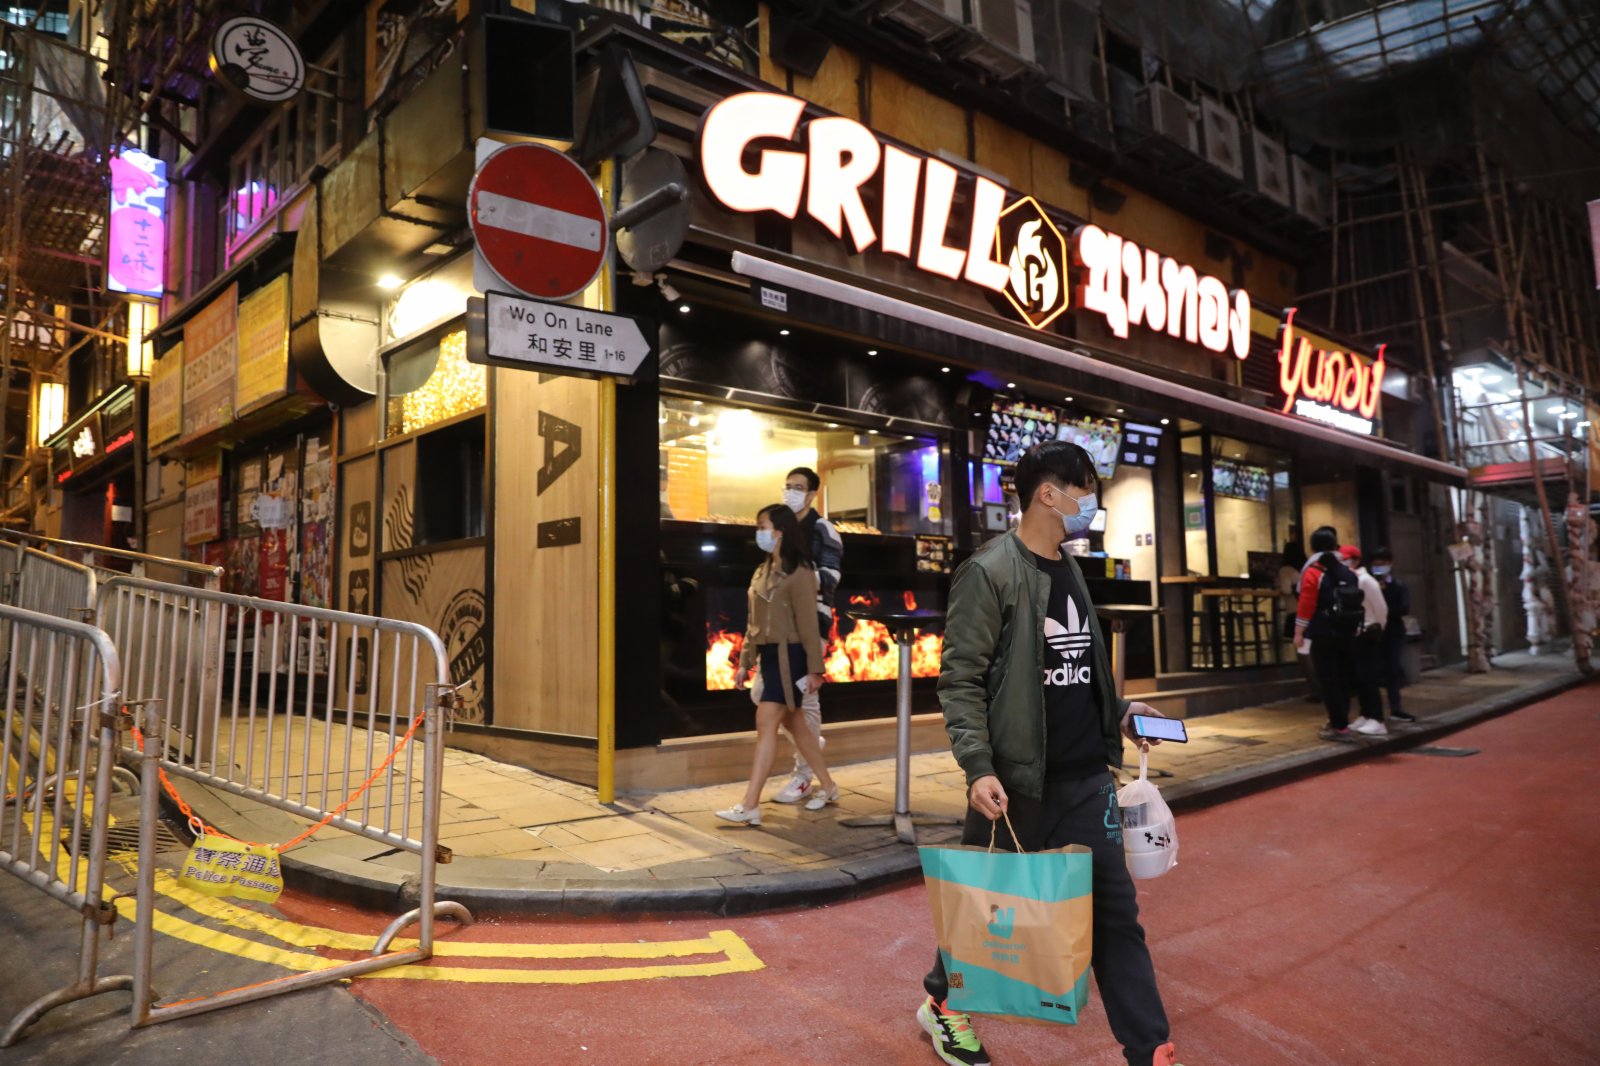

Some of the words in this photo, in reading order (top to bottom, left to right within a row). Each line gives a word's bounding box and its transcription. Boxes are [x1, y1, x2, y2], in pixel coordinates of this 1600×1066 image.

[701, 91, 1012, 293] GRILL
[509, 305, 536, 325] Wo
[544, 311, 567, 330] On
[576, 317, 613, 337] Lane
[527, 333, 597, 362] 和安里
[604, 348, 626, 362] 1-16
[184, 866, 227, 884] Police
[230, 875, 281, 893] Passage
